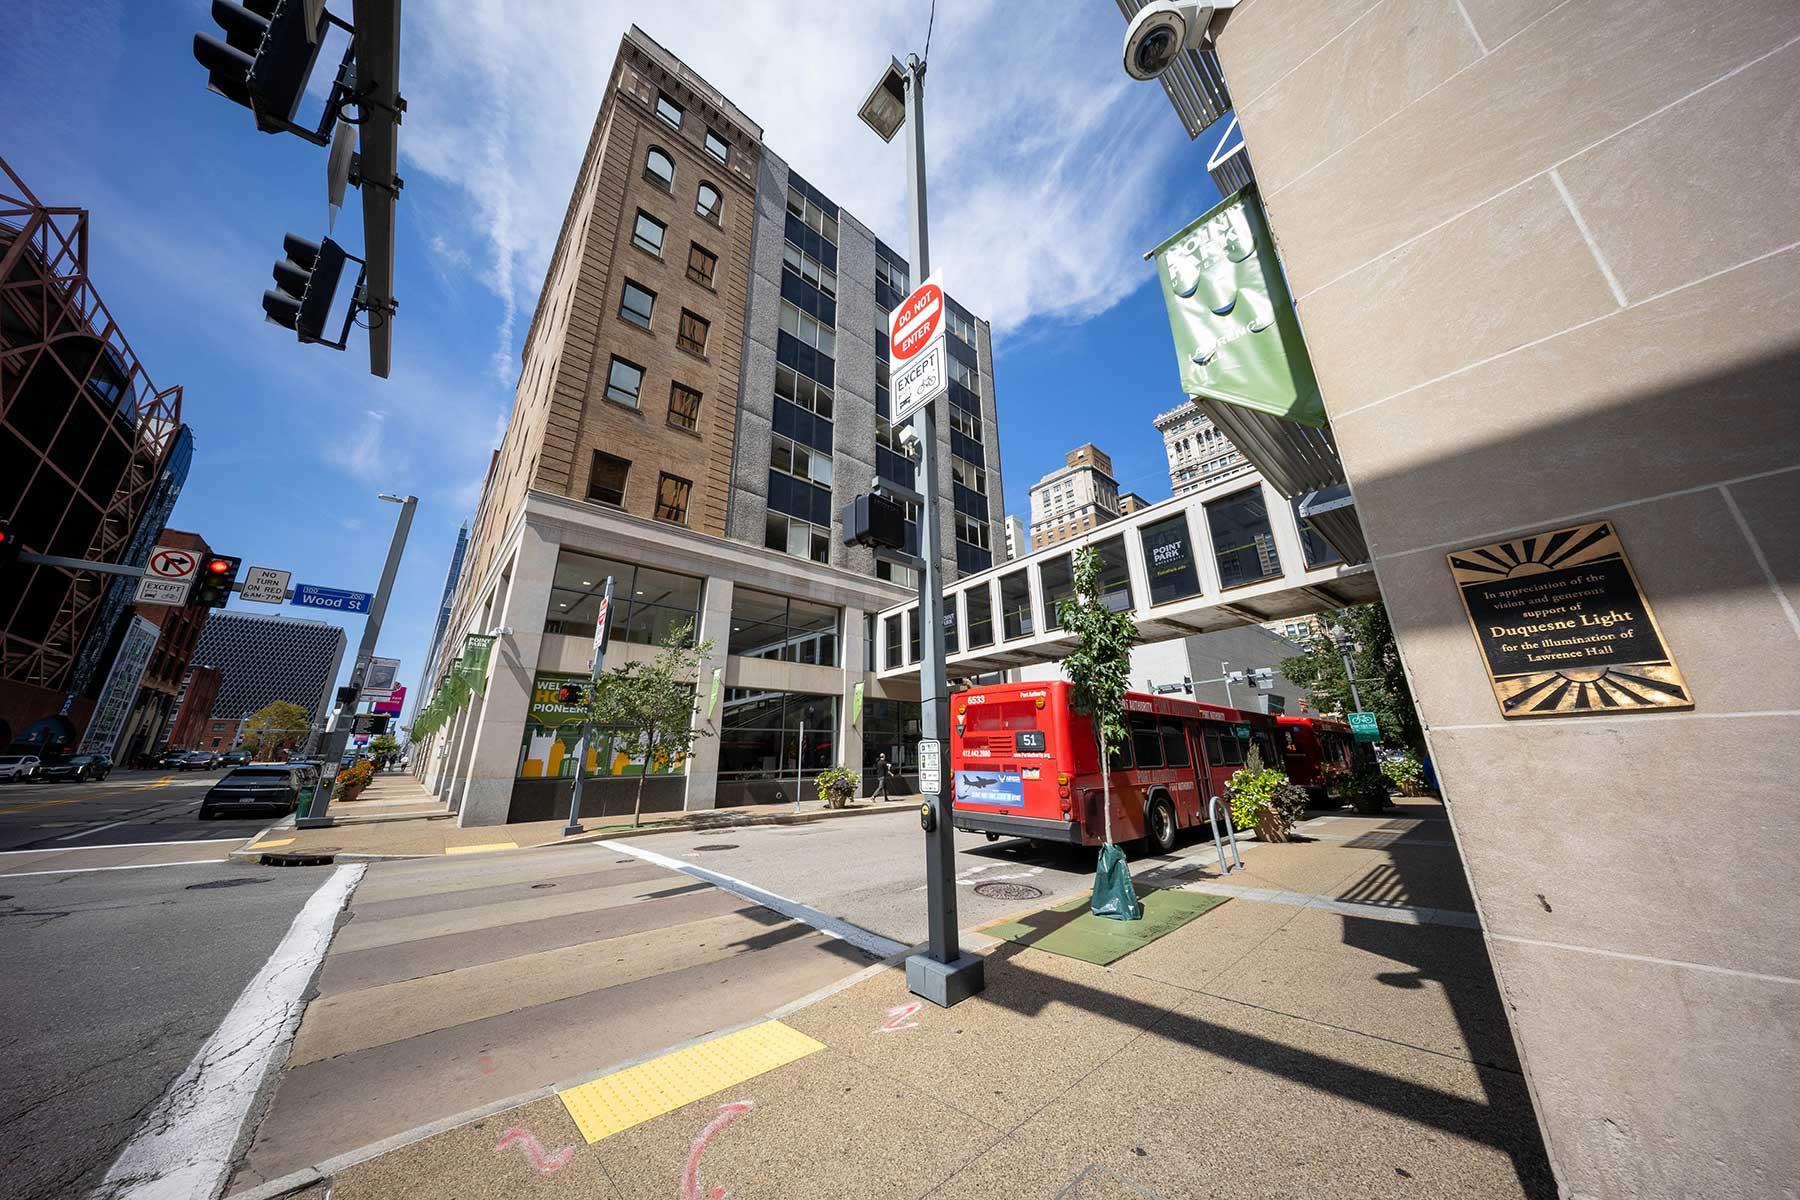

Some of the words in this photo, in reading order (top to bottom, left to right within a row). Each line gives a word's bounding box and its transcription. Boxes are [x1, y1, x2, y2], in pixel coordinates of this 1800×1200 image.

[899, 310, 911, 328] DO
[914, 290, 932, 312] NOT
[902, 321, 931, 352] ENTER
[898, 354, 935, 392] EXCEPT
[1153, 540, 1182, 556] POINT
[1154, 549, 1179, 562] PARK
[147, 582, 181, 593] EXCEPT
[257, 578, 280, 586] TURN
[1484, 591, 1496, 600] In
[1498, 580, 1567, 599] appreciation
[1570, 576, 1583, 587] of
[1585, 573, 1605, 584] the
[303, 594, 343, 608] Wood
[348, 600, 361, 610] St
[1493, 600, 1525, 611] vision
[1528, 595, 1549, 606] and
[1552, 588, 1605, 604] generous
[1523, 606, 1567, 619] support
[1569, 602, 1582, 612] of
[1489, 617, 1576, 638] Duquesne
[1580, 609, 1634, 628] Light
[1501, 642, 1519, 653] for
[1520, 641, 1540, 651] the
[1542, 632, 1616, 648] illumination
[1620, 629, 1635, 639] of
[1528, 649, 1583, 663] Lawrence
[1585, 645, 1614, 657] Hall
[967, 695, 985, 705] 6533
[1023, 734, 1037, 746] 51
